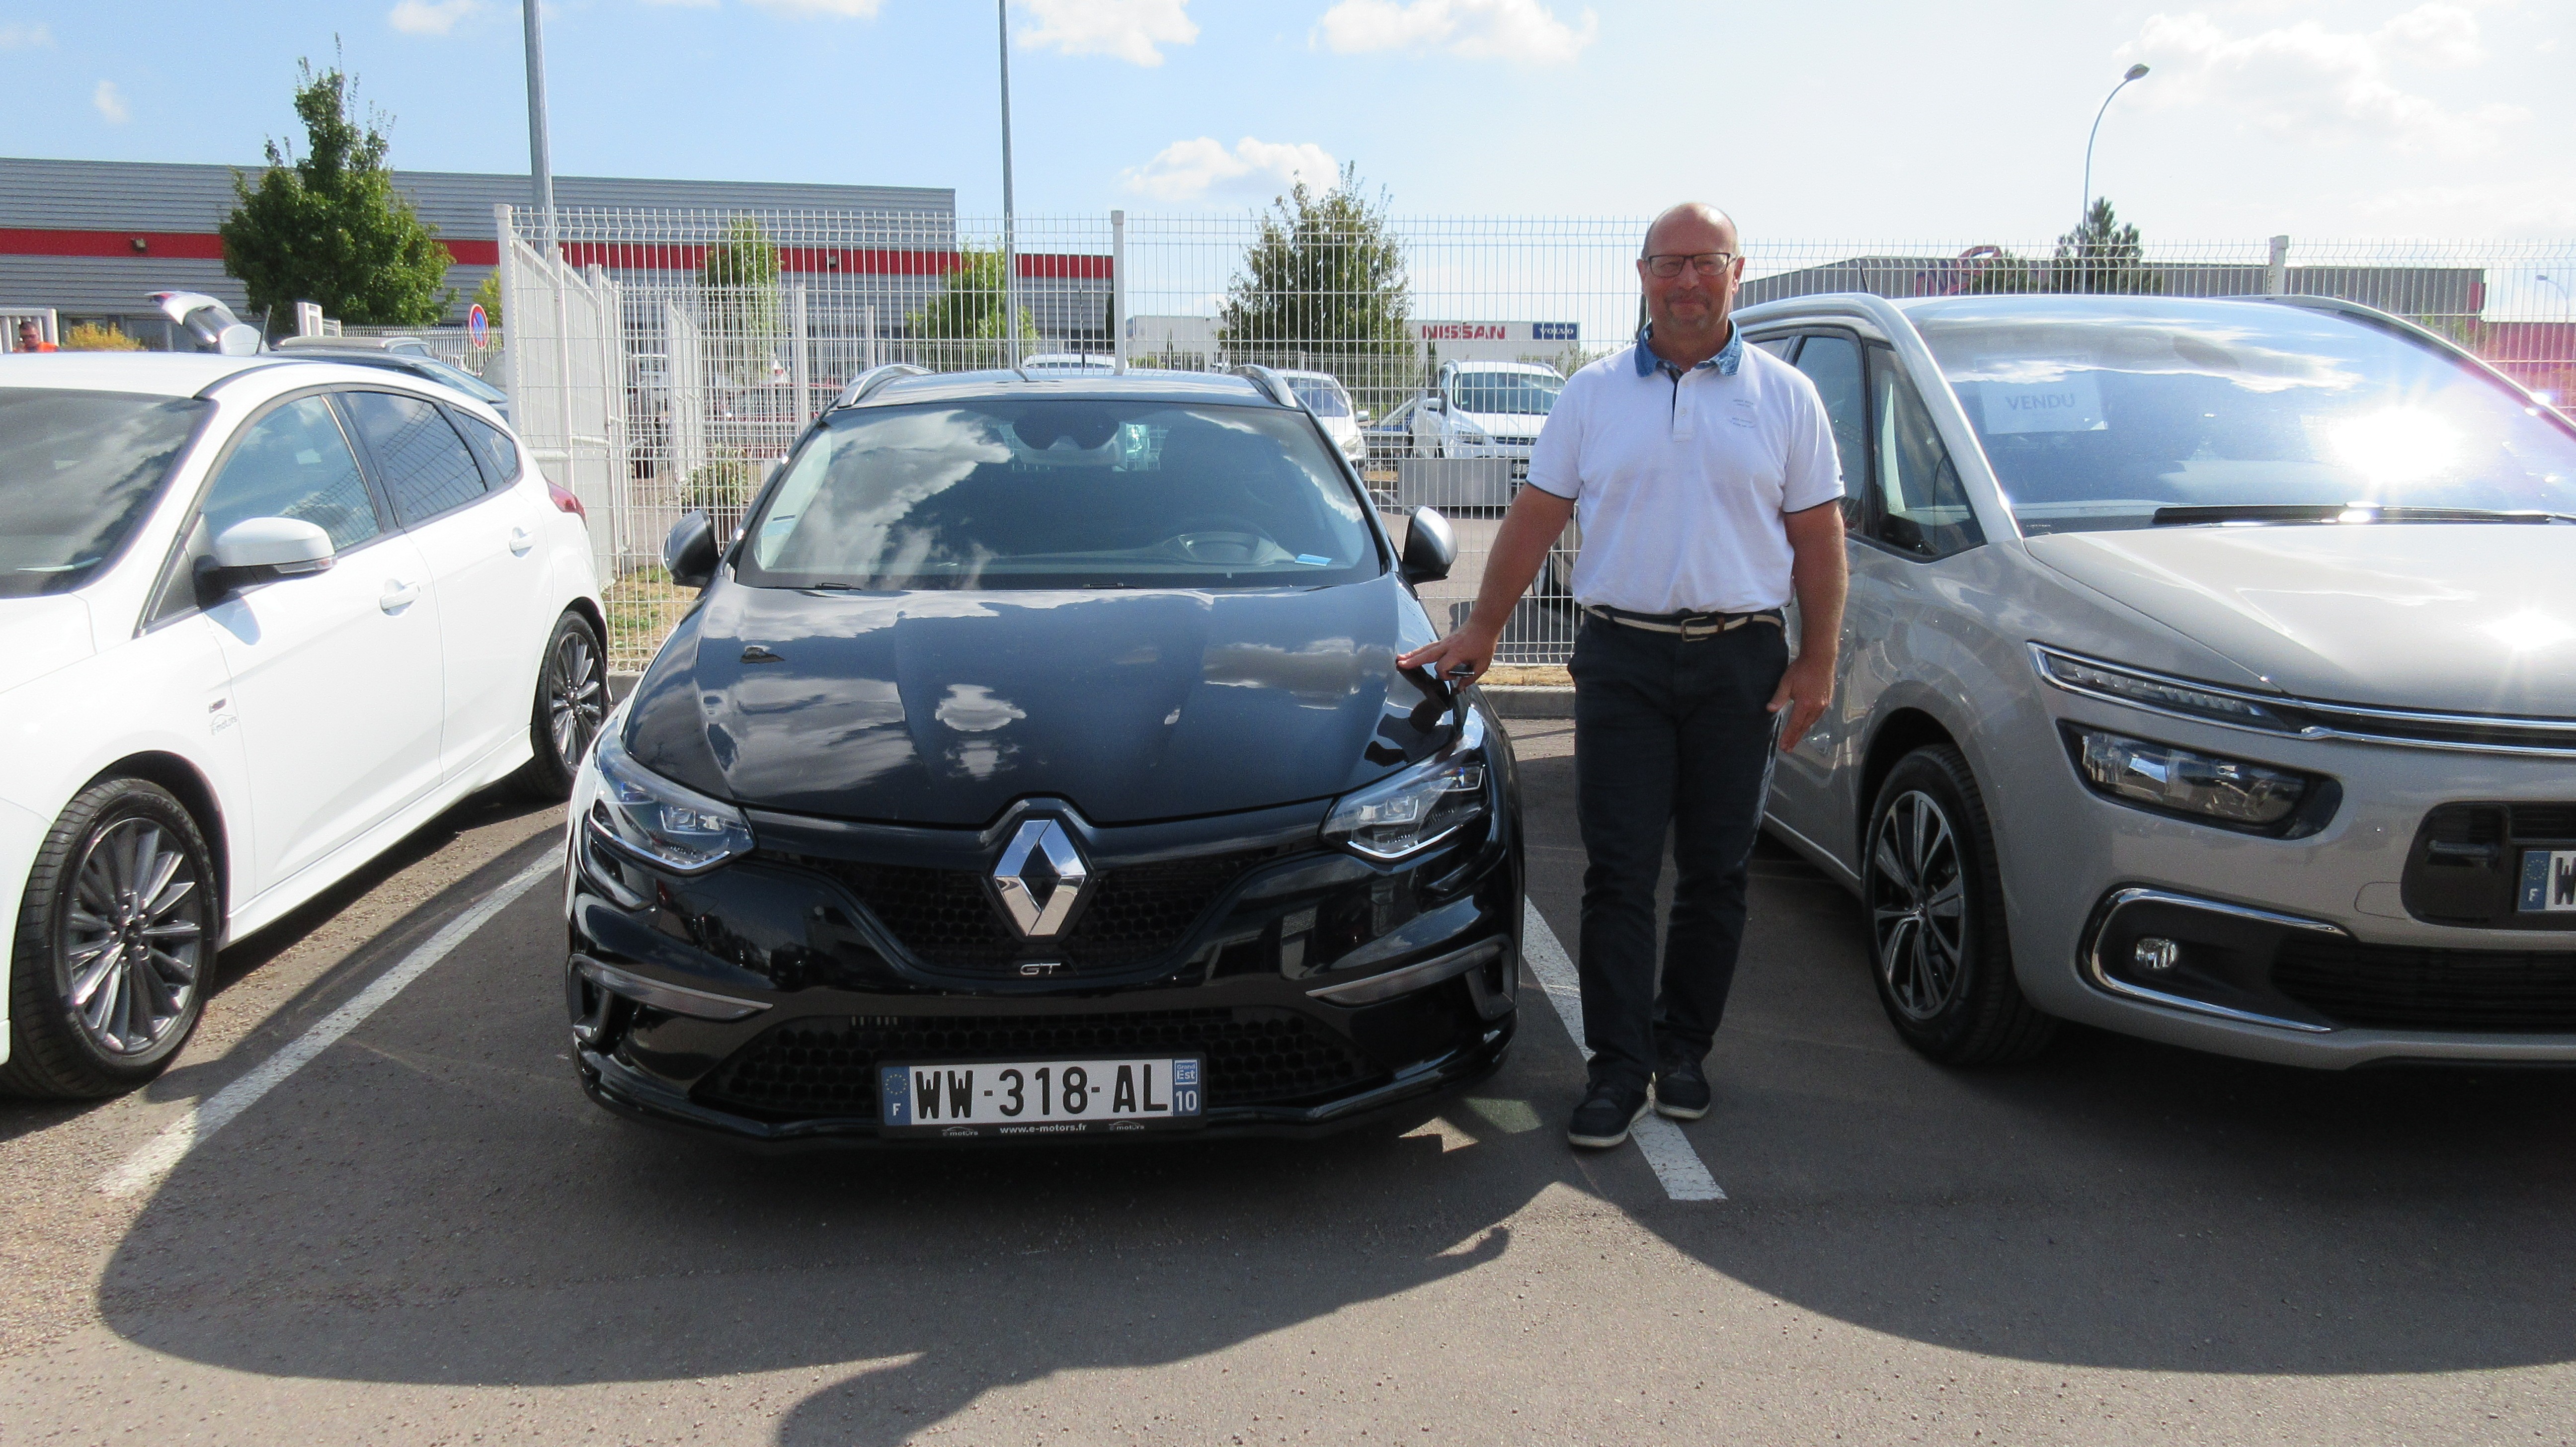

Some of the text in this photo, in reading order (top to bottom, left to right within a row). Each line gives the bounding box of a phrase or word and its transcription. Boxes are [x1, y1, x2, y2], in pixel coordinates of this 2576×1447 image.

[1422, 325, 1507, 339] NISSAN
[2005, 394, 2075, 410] VENDU
[2528, 888, 2540, 902] F
[1020, 963, 1061, 975] GT
[1177, 1070, 1195, 1080] Est
[1176, 1090, 1197, 1112] 10
[893, 1103, 901, 1116] F
[1000, 1123, 1087, 1133] www.e-motors.fr
